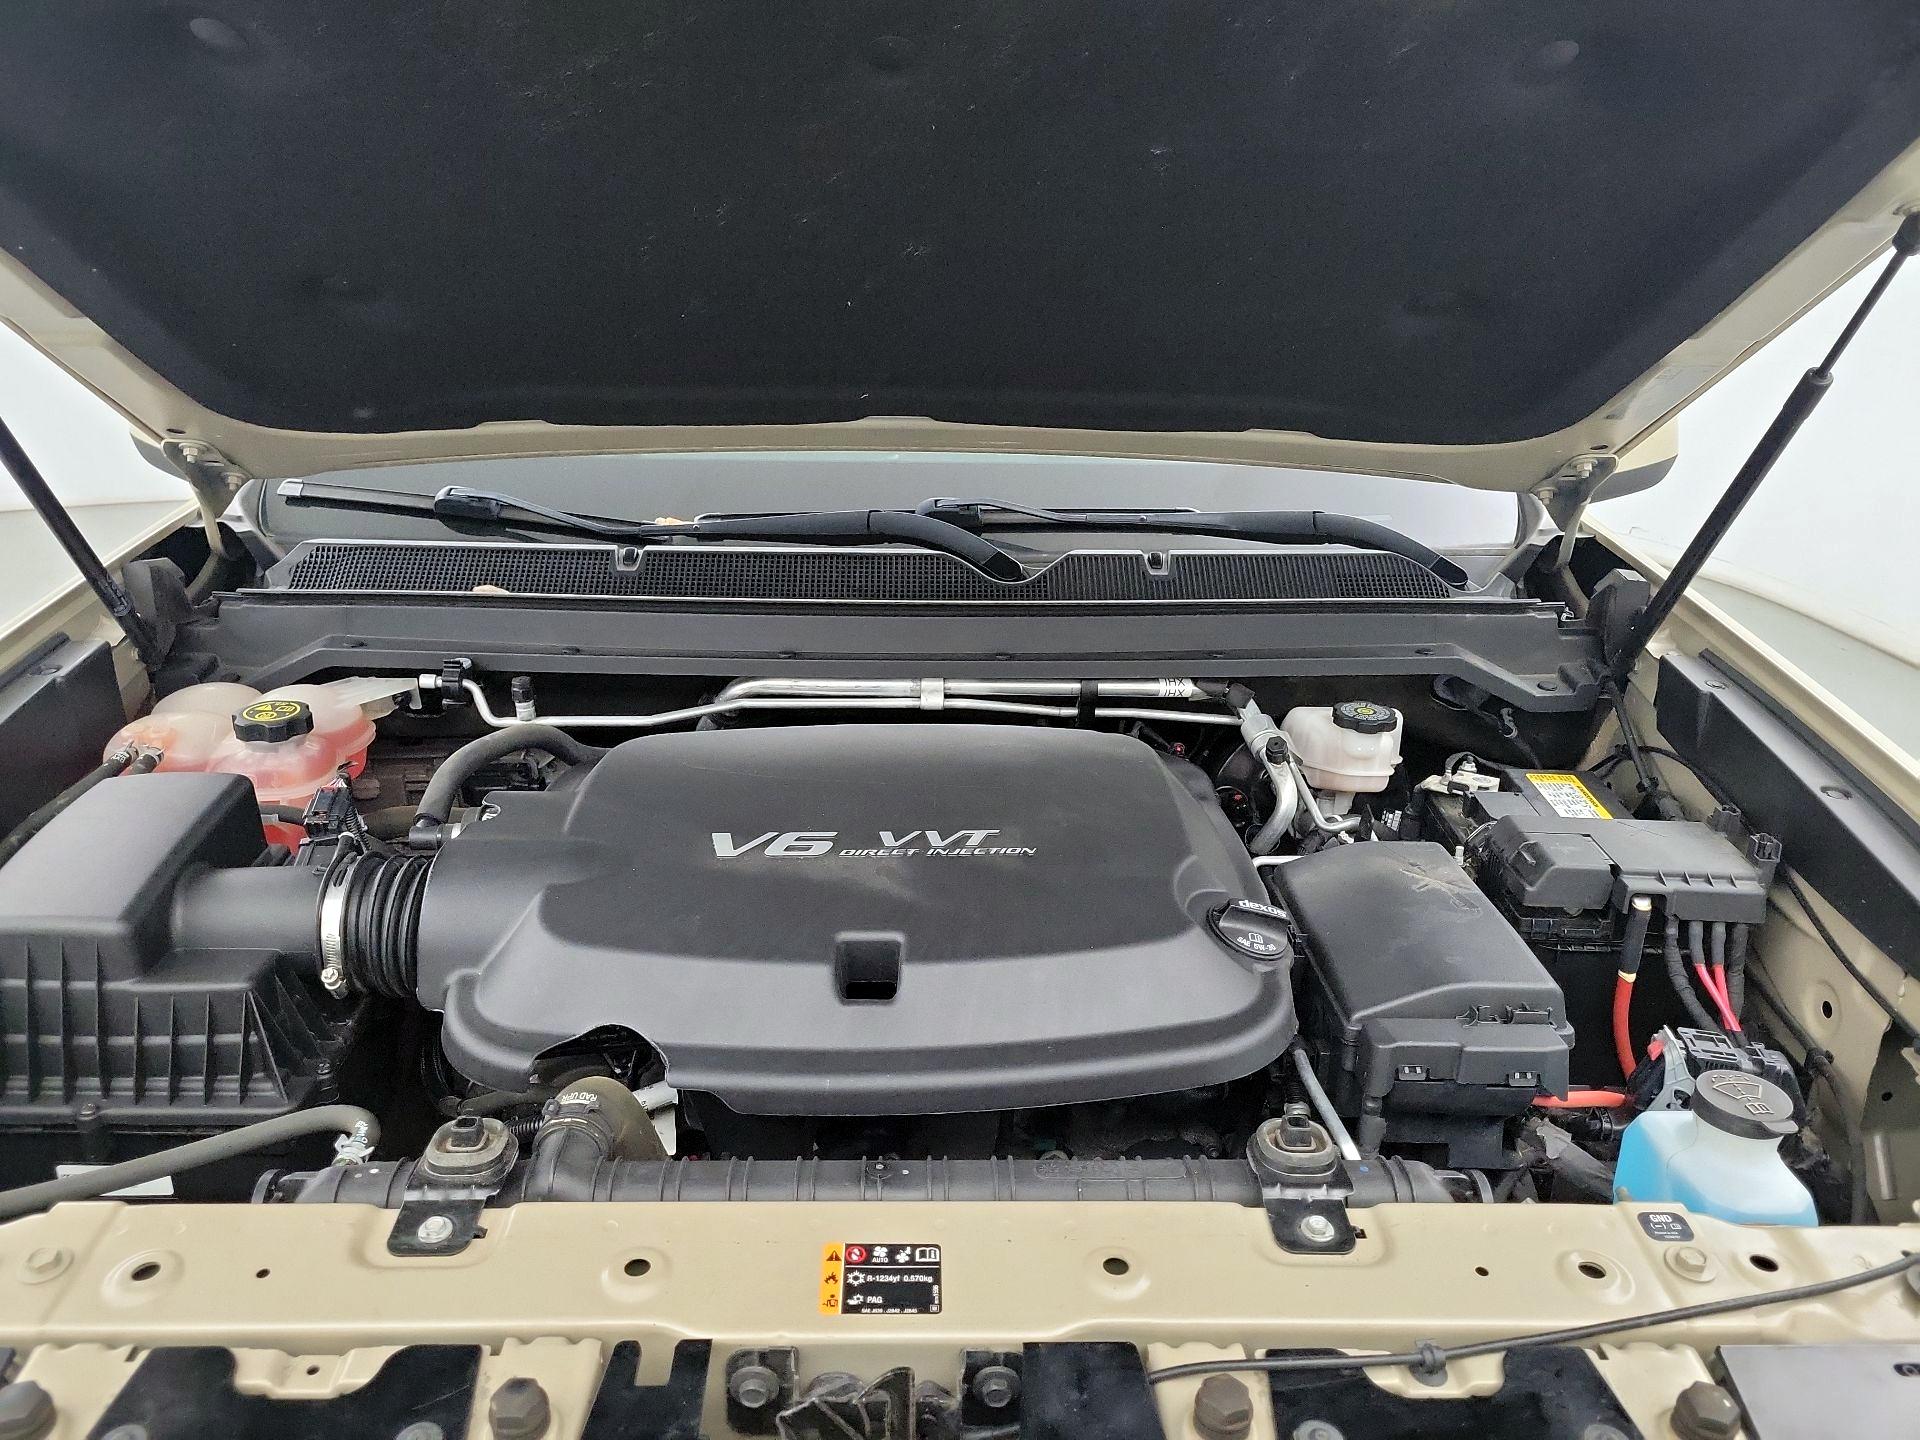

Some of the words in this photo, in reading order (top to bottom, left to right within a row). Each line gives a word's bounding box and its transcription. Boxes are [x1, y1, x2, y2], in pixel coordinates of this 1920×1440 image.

[711, 831, 838, 858] V6
[879, 829, 1001, 847] VVT
[838, 848, 919, 857] DIRECT
[925, 847, 1037, 857] INJECTION
[1238, 899, 1287, 918] dexos
[1237, 936, 1250, 947] SAE
[579, 1092, 598, 1102] RAD
[1649, 1214, 1672, 1223] GND
[867, 1274, 900, 1283] R-1234yf
[867, 1296, 883, 1304] PAG
